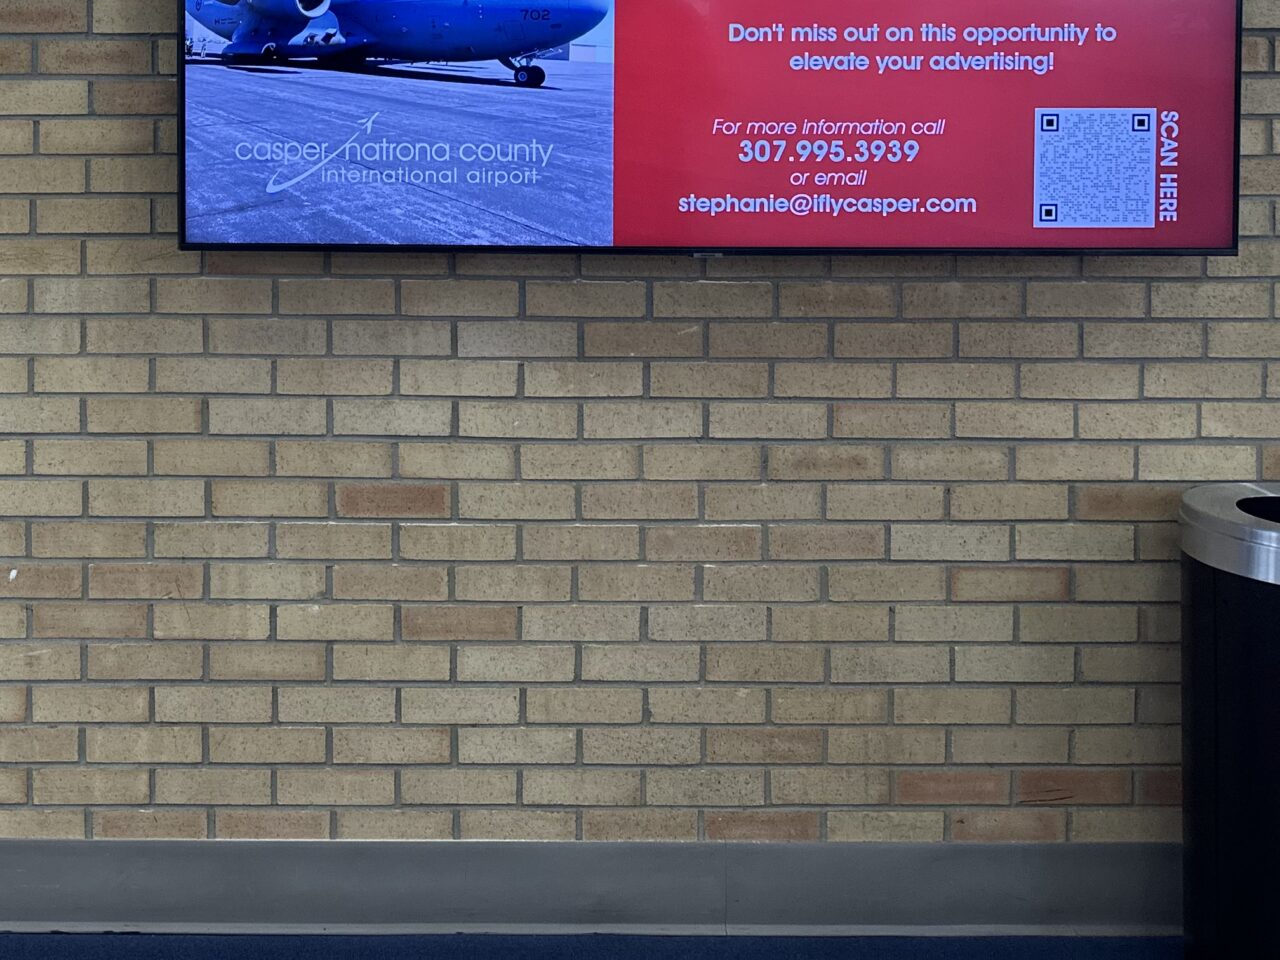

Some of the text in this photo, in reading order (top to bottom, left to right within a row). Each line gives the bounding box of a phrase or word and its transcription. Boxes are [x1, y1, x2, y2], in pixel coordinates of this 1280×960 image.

[520, 8, 551, 20] 702
[729, 23, 1116, 45] Don't miss out on this opportunity to
[790, 52, 1054, 74] elevate your advertising!
[713, 119, 945, 134] For more information call
[235, 138, 554, 167] casper natrona county
[739, 140, 919, 162] 307.995.3939
[321, 167, 538, 187] international airport
[790, 170, 867, 185] or email
[1160, 111, 1178, 222] SCAN HERE
[679, 194, 976, 216] stephanie@iflycasper.com
